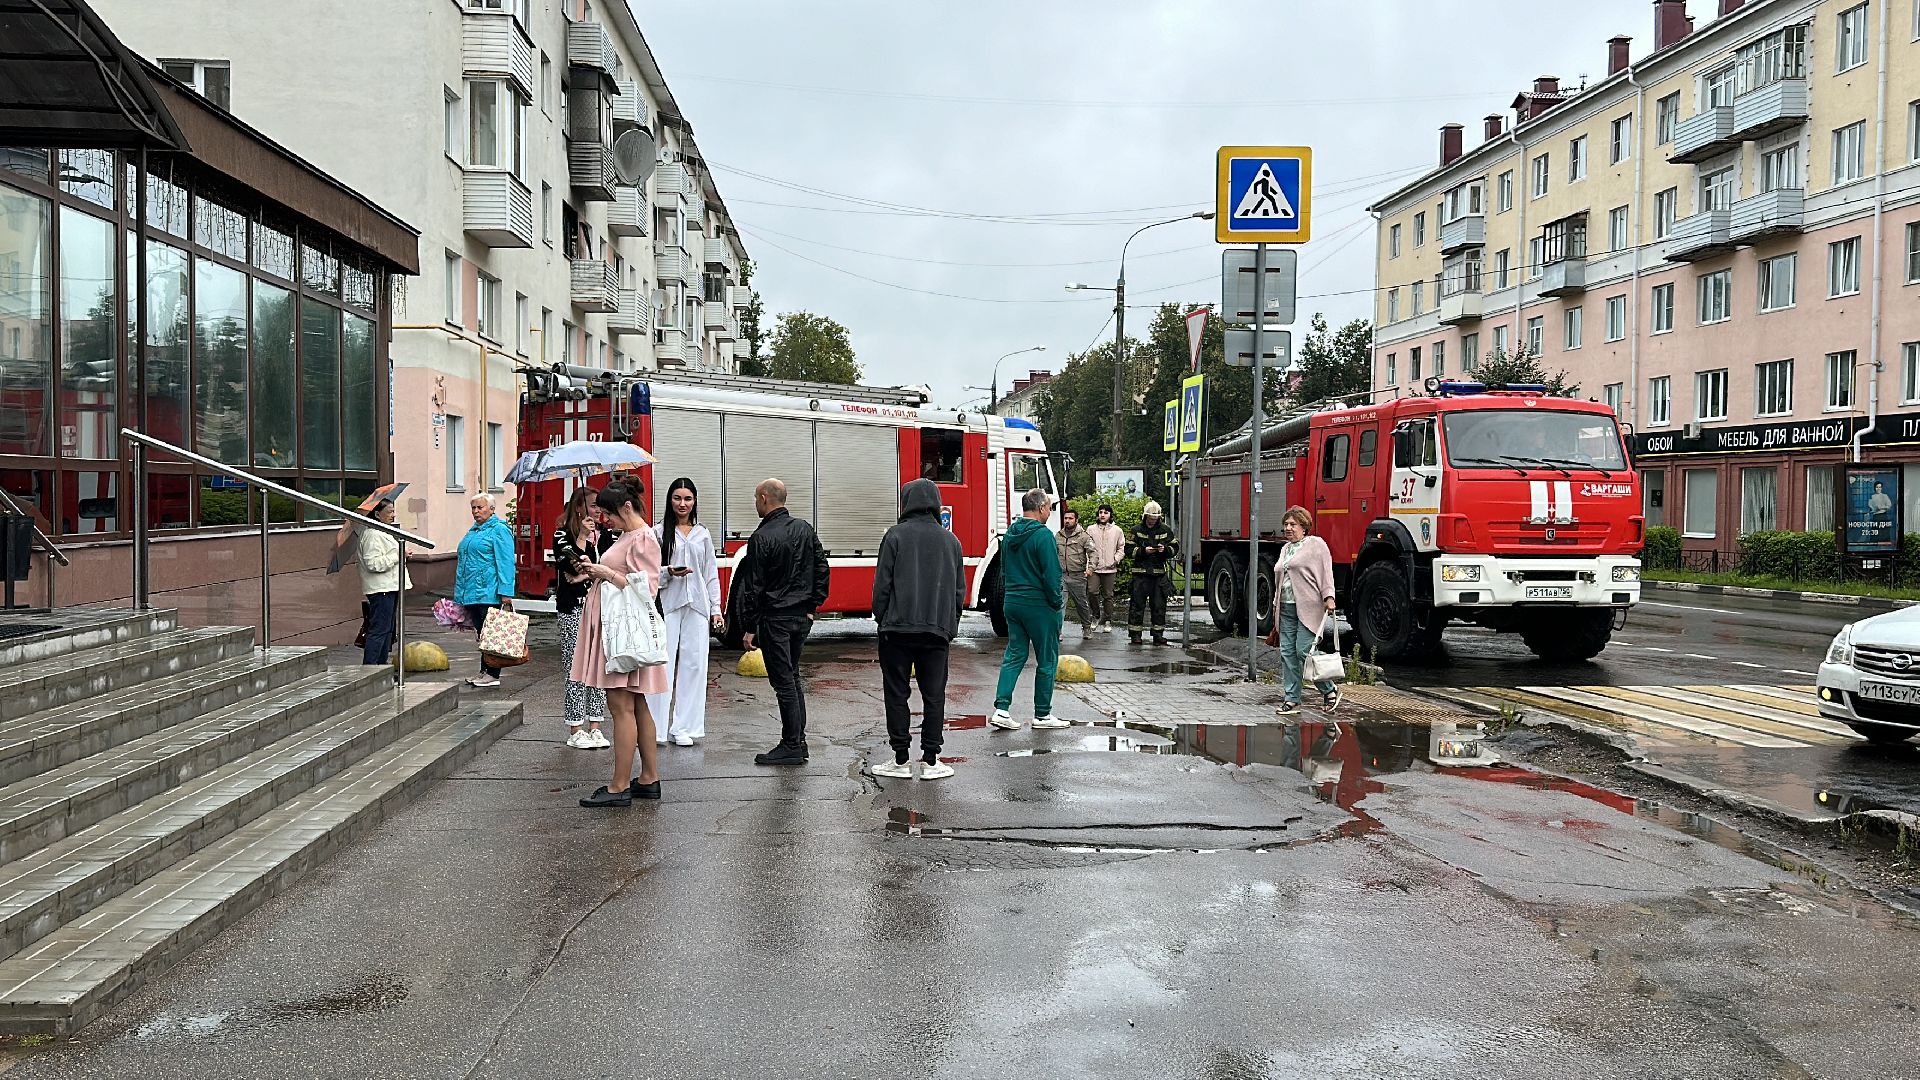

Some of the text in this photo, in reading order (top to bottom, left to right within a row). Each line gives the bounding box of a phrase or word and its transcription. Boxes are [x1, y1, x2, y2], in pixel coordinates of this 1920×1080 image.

[841, 405, 877, 414] ТЕЛЕФОН
[1718, 421, 1844, 448] МЕБЕЛЬ ДЛЯ ВАННОЙ
[1647, 436, 1673, 451] ОБОИ
[1402, 477, 1416, 496] 37
[1591, 484, 1632, 494] ВАРГАШИ
[1863, 685, 1908, 700] У113СУ
